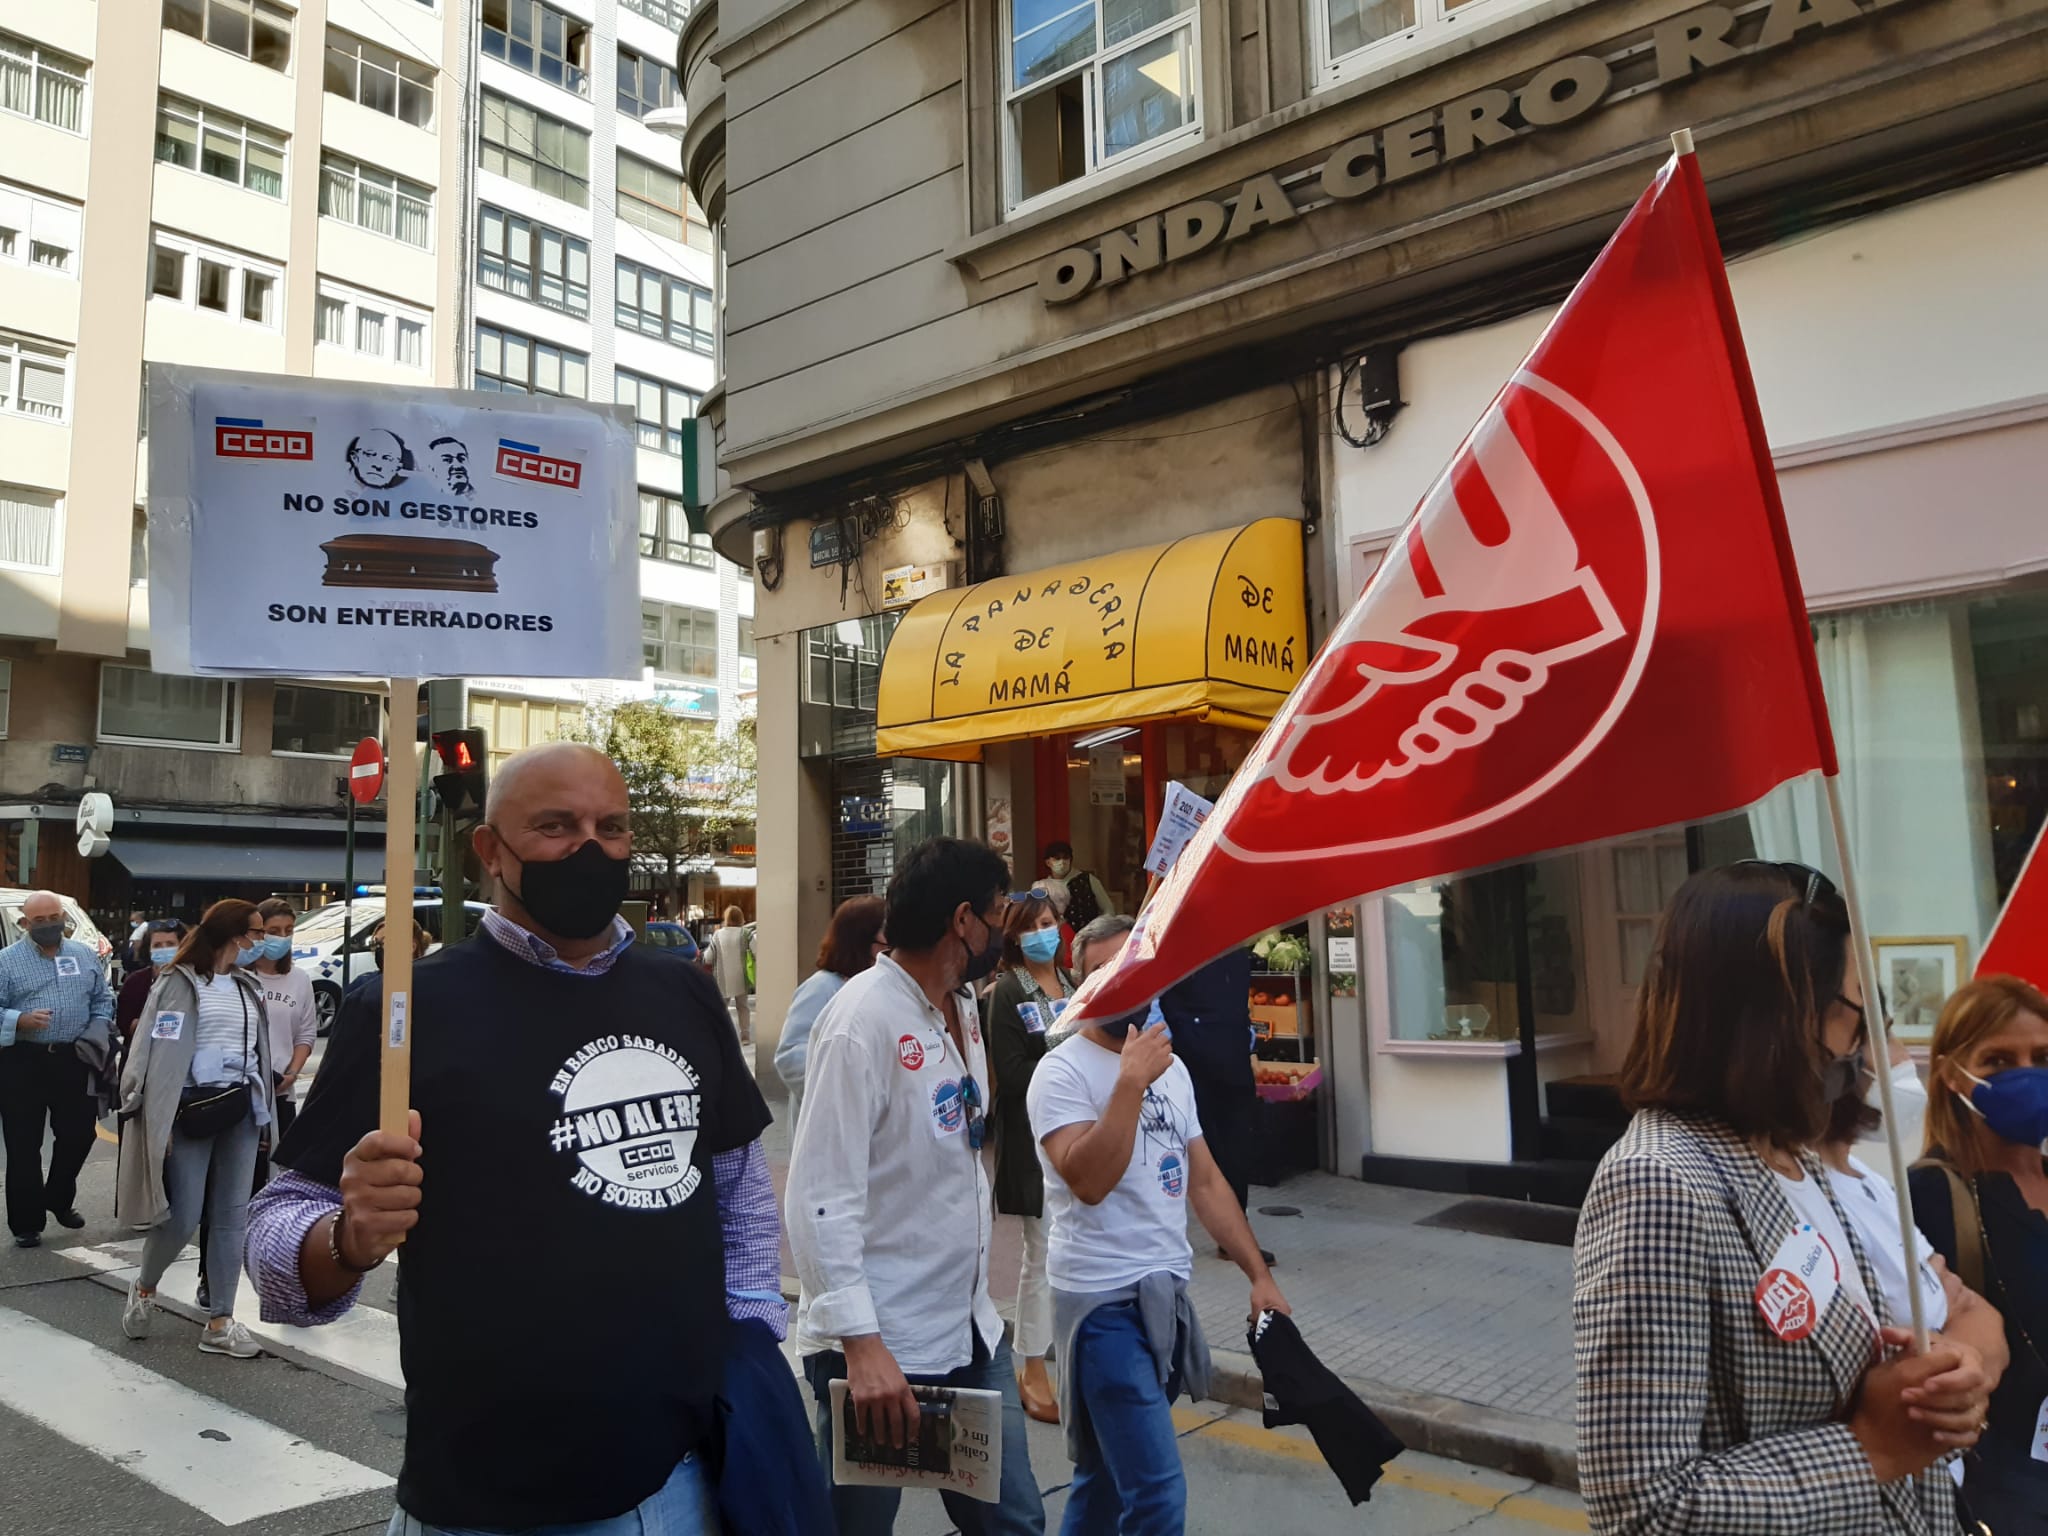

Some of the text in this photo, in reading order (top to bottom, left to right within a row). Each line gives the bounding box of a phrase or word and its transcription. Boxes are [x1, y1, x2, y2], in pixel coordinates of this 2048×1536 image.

[1036, 0, 1880, 302] ONDA CERO RA
[221, 431, 308, 456] CCOO
[500, 452, 577, 484] CCOO
[283, 493, 323, 513] NO
[333, 498, 390, 518] SON
[401, 501, 539, 529] GESTORES
[1237, 574, 1274, 614] DE
[268, 604, 553, 632] SON ENTERRADORES
[1013, 626, 1054, 652] DE
[1225, 633, 1295, 674] MAMÁ
[940, 651, 966, 686] LA
[989, 659, 1074, 705] MAMÁ
[550, 1068, 573, 1094] EN
[565, 1034, 619, 1073] BANCO
[900, 1038, 921, 1056] UGT
[549, 1094, 701, 1152] #NO AL ERE
[623, 1143, 673, 1166] CCOO
[626, 1162, 680, 1182] servicios
[570, 1166, 603, 1195] NO
[602, 1182, 669, 1209] SOBRA
[1800, 1245, 1823, 1277] Galicia
[1759, 1271, 1799, 1328] UGT
